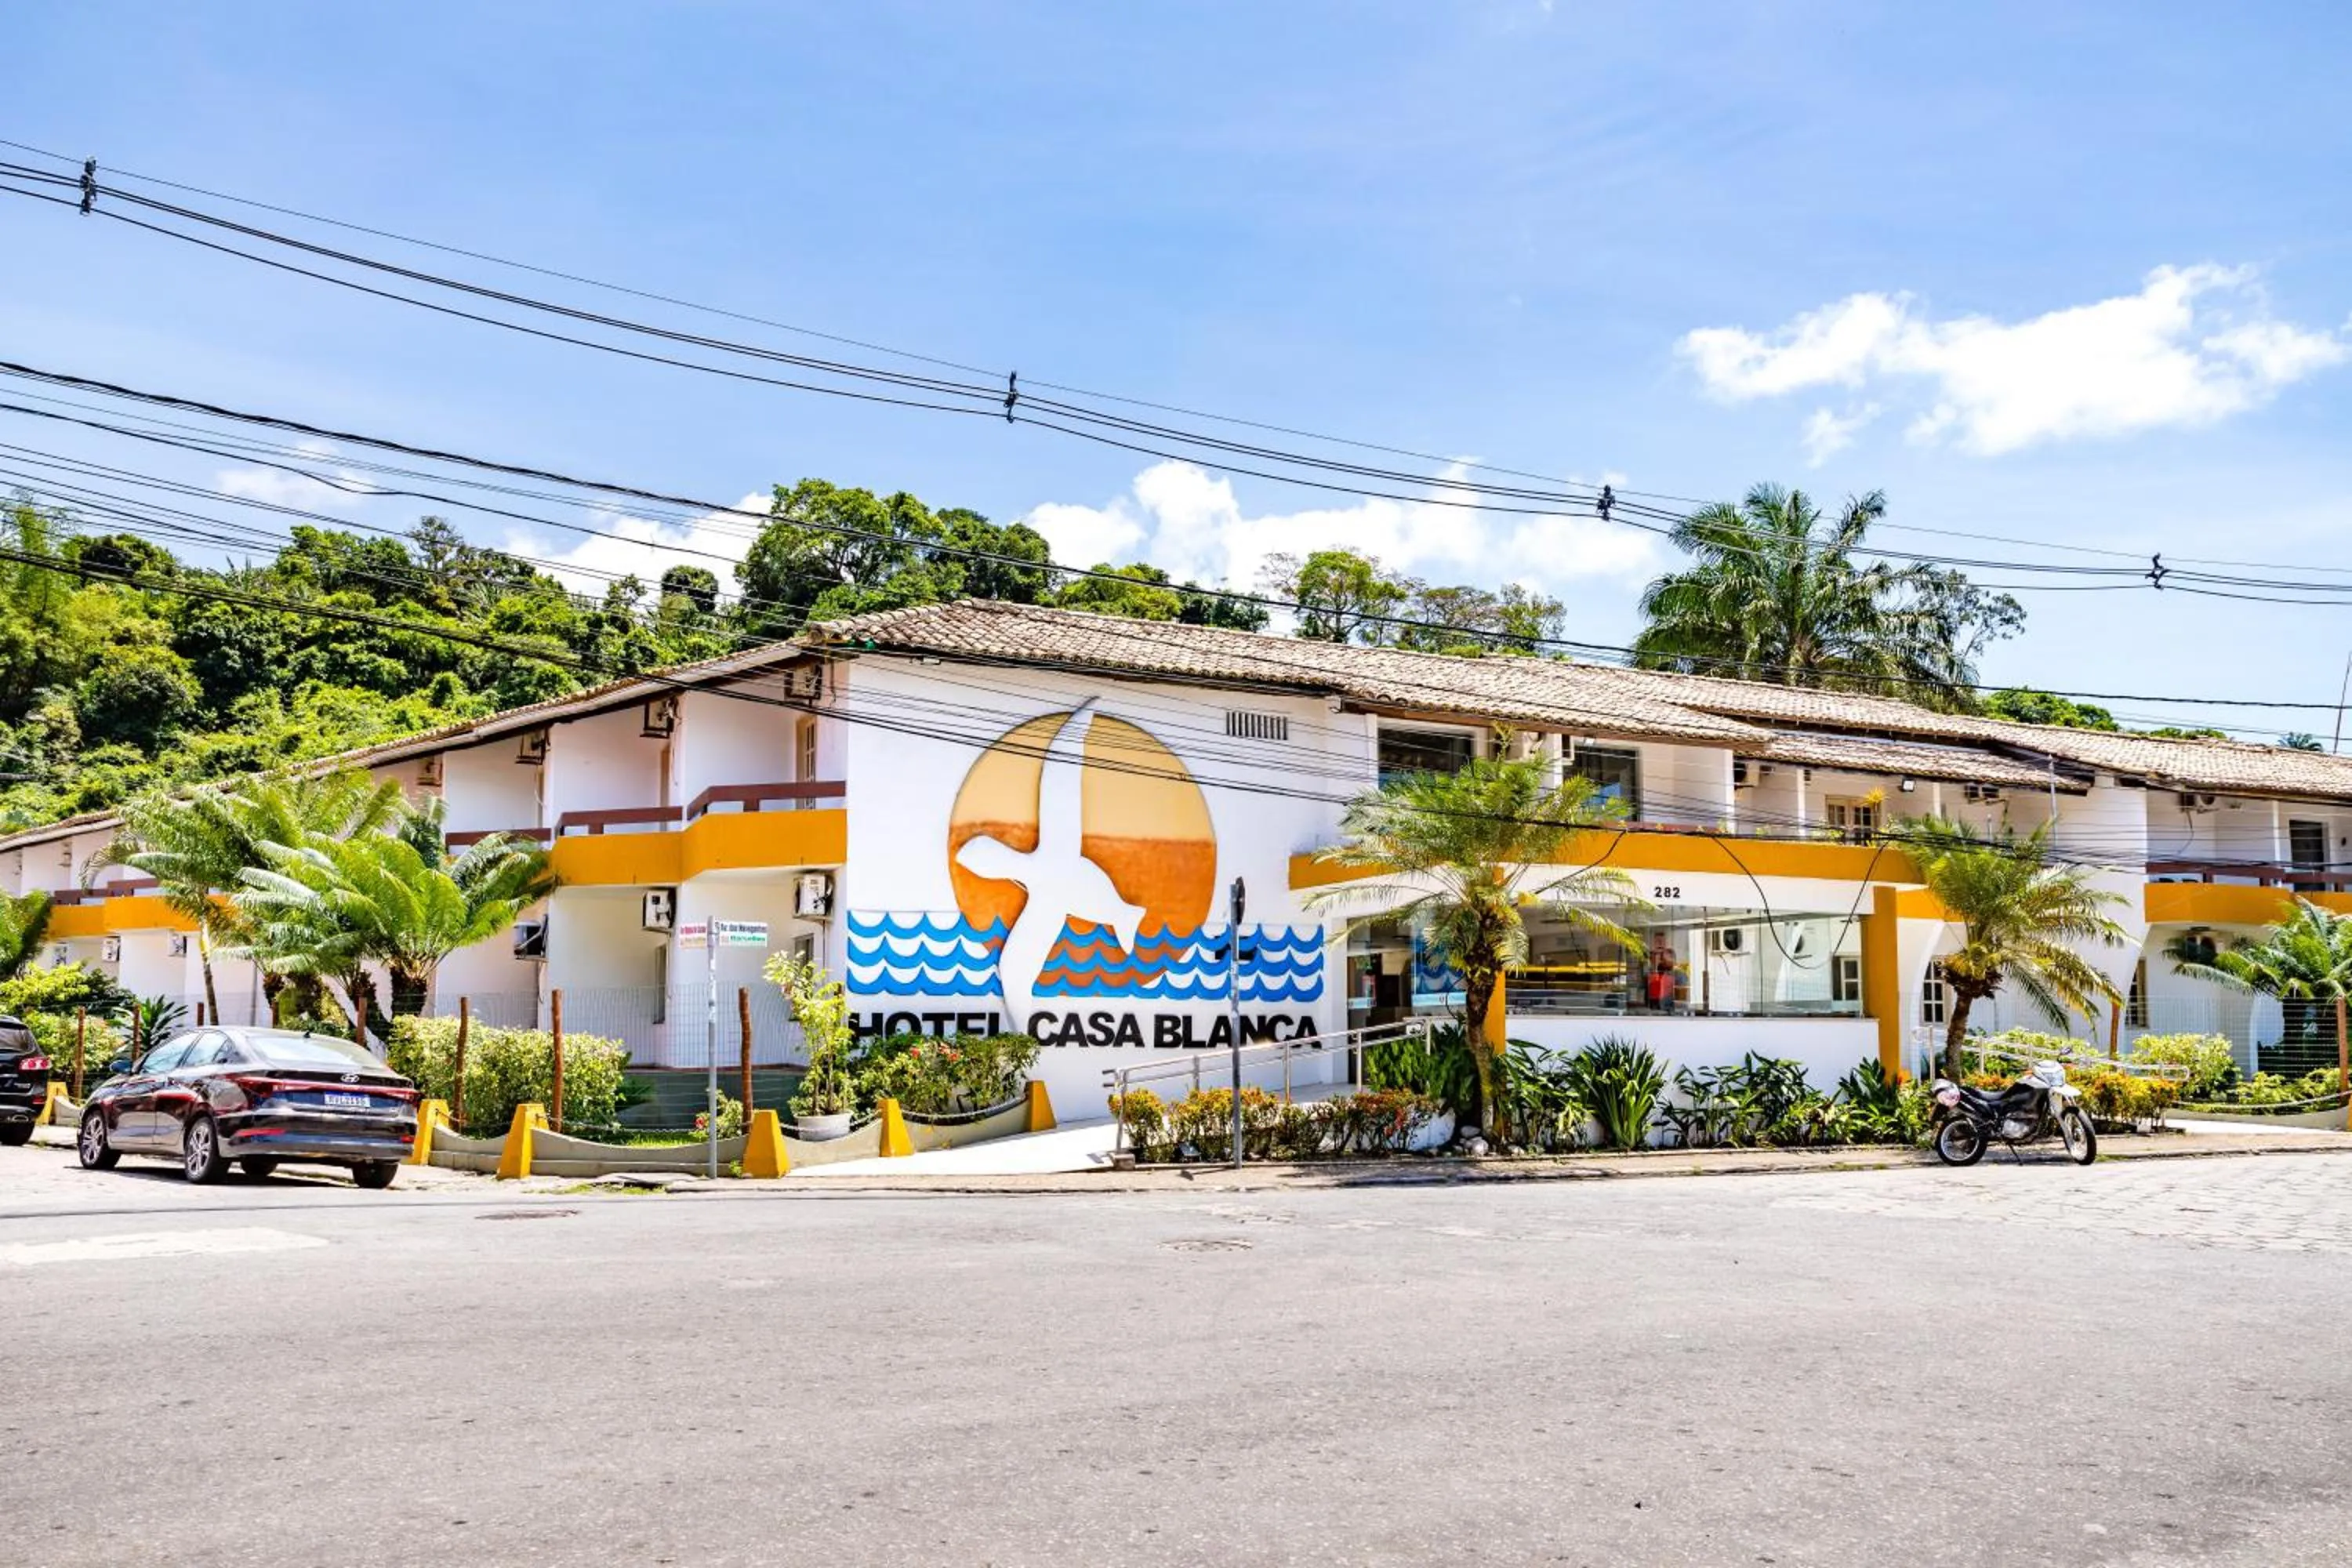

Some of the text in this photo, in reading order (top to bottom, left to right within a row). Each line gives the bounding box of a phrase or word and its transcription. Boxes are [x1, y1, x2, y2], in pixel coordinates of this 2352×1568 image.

[1654, 887, 1680, 898] 282
[1027, 1011, 1145, 1047] CASA
[1154, 1014, 1323, 1049] BLANCA
